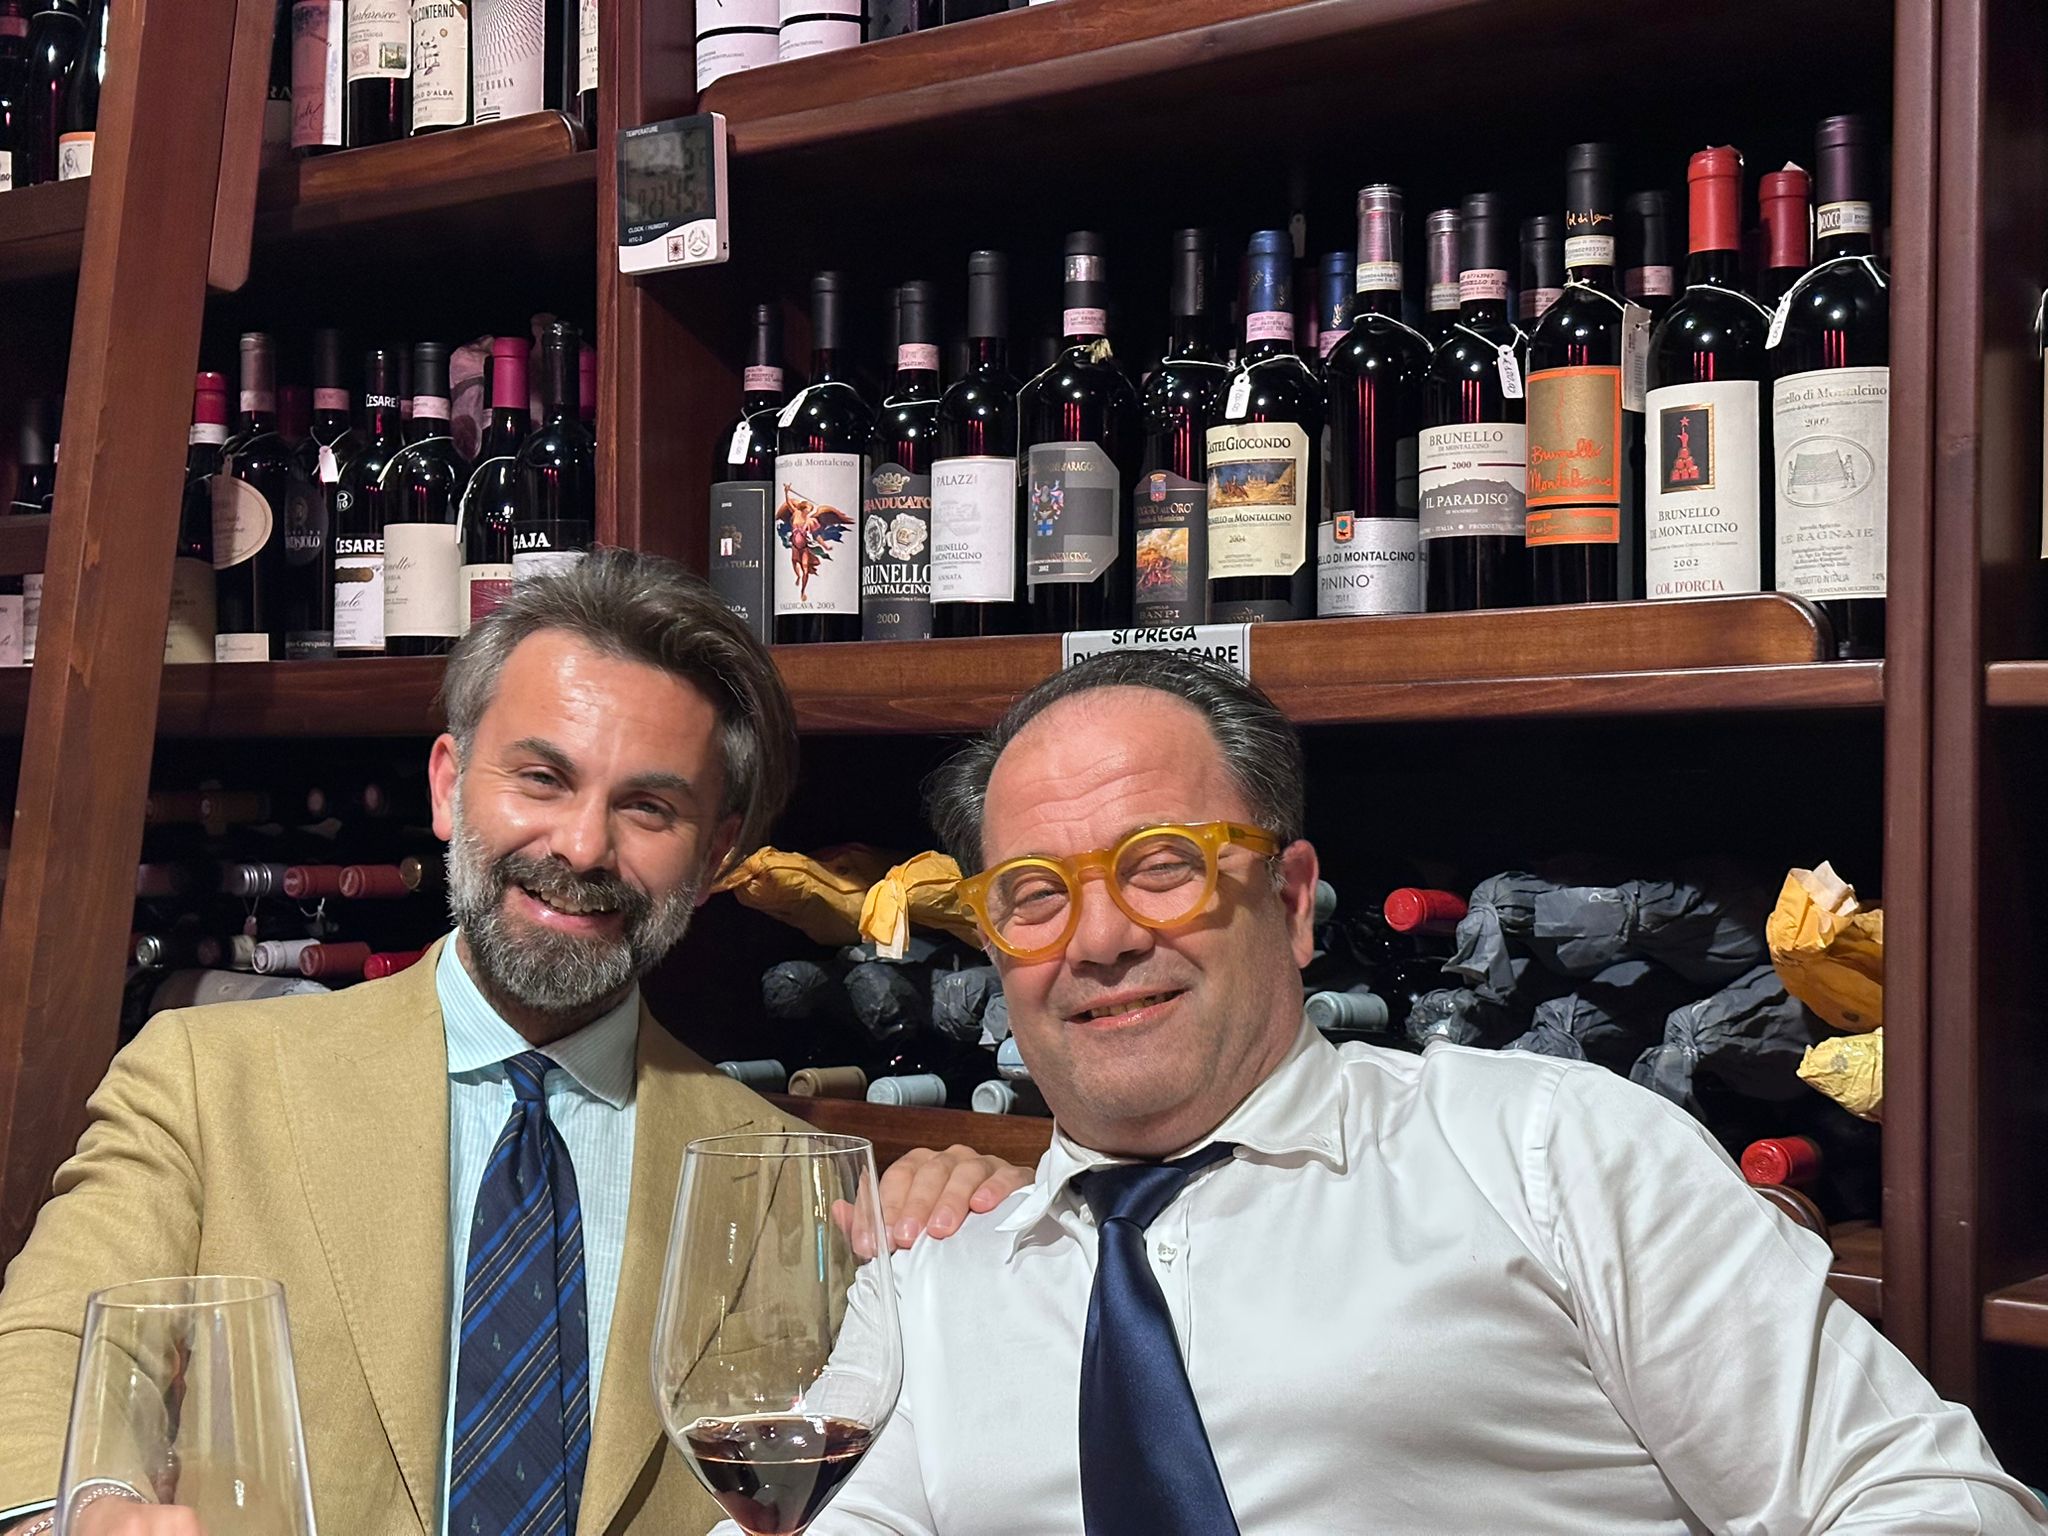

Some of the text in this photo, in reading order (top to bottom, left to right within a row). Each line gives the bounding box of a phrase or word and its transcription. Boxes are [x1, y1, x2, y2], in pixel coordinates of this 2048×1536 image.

[418, 4, 455, 21] CONTERNO
[626, 125, 659, 138] TEMPERATURE
[628, 226, 644, 234] CLOCK
[366, 393, 396, 408] CESARE
[1803, 389, 1814, 400] di
[1430, 430, 1503, 447] BRUNELLO
[1445, 443, 1489, 452] MONTALCINO
[805, 458, 855, 468] Montalcino
[1452, 461, 1472, 470] 2000
[864, 496, 932, 512] RANDUCATO
[1425, 493, 1508, 510] IL PARADISO
[1235, 513, 1292, 523] MONTALCINO
[1658, 506, 1721, 521] BRUNELLO
[1658, 522, 1738, 538] MONTALCINO
[1796, 528, 1874, 543] RAGNAIE
[335, 537, 384, 554] CESARE
[512, 532, 551, 550] GAJA
[935, 543, 969, 552] BRUNELLO
[935, 551, 982, 561] MONTALCINO
[1333, 553, 1342, 564] DI
[1344, 551, 1416, 562] MONTALCINO
[1673, 559, 1699, 569] 2002
[1321, 574, 1370, 591] PININO
[1655, 580, 1725, 596] COL D'ORCIA
[867, 584, 931, 596] MONTALCINO
[877, 613, 900, 625] 2000
[1112, 627, 1197, 645] SI PREGA
